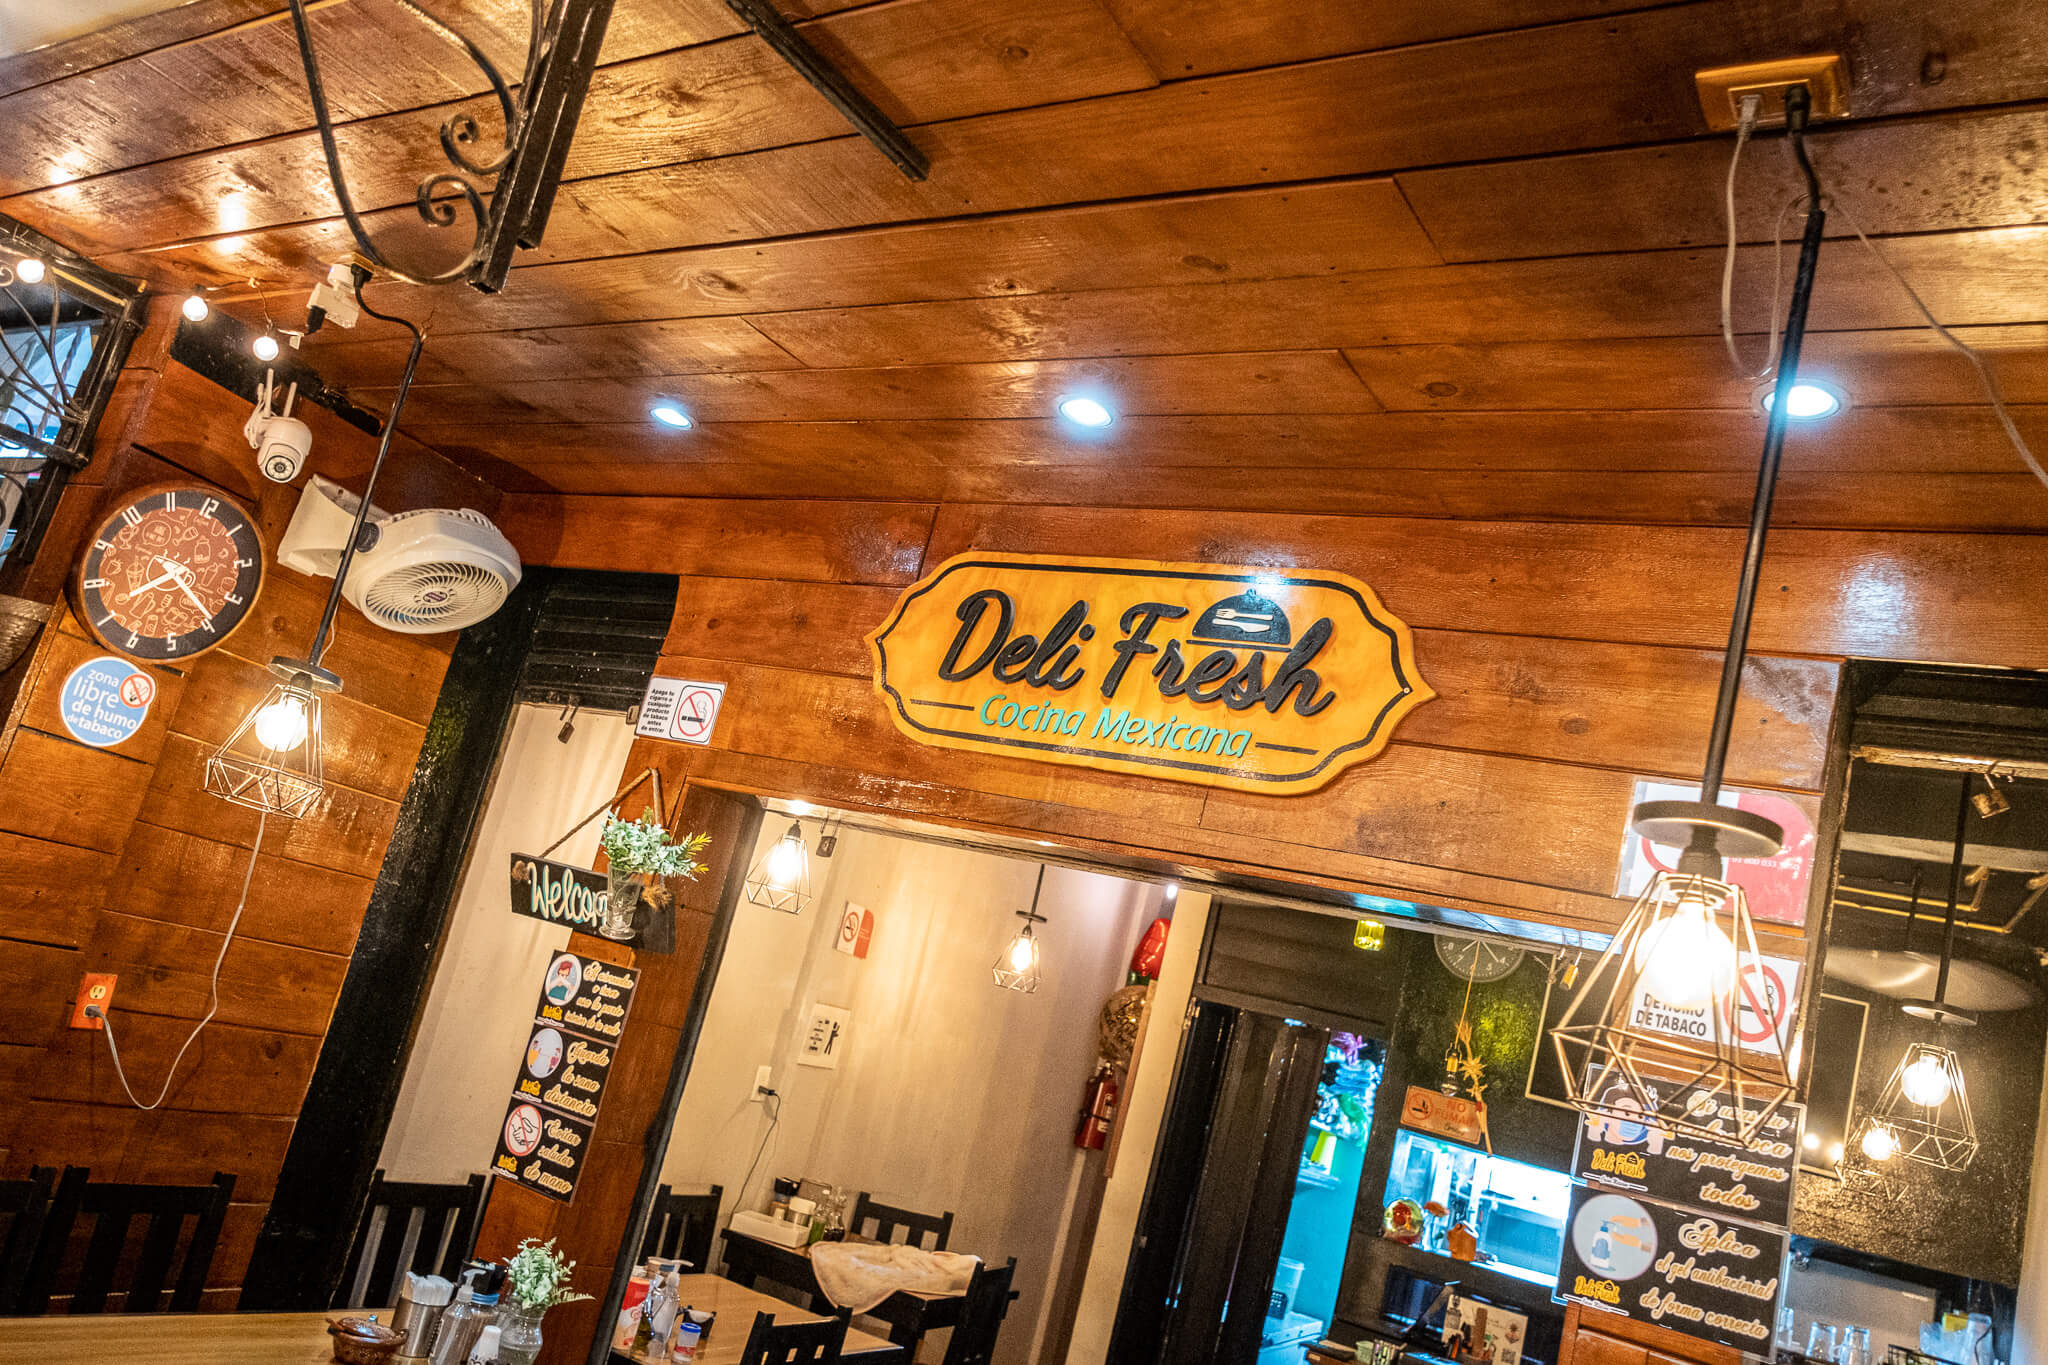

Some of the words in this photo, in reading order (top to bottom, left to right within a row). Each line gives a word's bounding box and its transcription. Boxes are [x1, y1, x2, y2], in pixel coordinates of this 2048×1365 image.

[166, 492, 176, 512] 11
[199, 497, 220, 520] 12
[121, 505, 143, 528] 10
[225, 523, 243, 537] 1
[95, 539, 115, 551] 9
[234, 558, 252, 569] 2
[83, 578, 105, 590] 8
[224, 592, 243, 605] 3
[97, 609, 116, 627] 7
[200, 618, 215, 633] 4
[125, 630, 139, 649] 6
[167, 632, 177, 652] 5
[938, 589, 1095, 690] Deli
[1100, 602, 1336, 716] Fresh
[88, 669, 120, 687] zona
[73, 676, 119, 708] libre
[67, 713, 79, 723] de
[78, 716, 122, 739] tabaco
[72, 699, 92, 715] de
[94, 704, 137, 730] humo
[980, 694, 1086, 735] Cocina
[1091, 708, 1252, 758] Mexicana
[527, 861, 610, 927] Welco
[1635, 1010, 1653, 1026] DE
[1656, 1014, 1706, 1036] TABACO
[567, 1041, 609, 1067] Guarda
[561, 1065, 575, 1084] la
[573, 1075, 600, 1092] sana
[544, 1083, 597, 1117] distancia
[1718, 1106, 1760, 1124] uas
[544, 1119, 581, 1147] Evitar
[538, 1144, 575, 1168] saludar
[1665, 1145, 1698, 1162] nos
[1690, 1152, 1790, 1182] protegemos
[523, 1160, 541, 1180] de
[538, 1172, 572, 1194] mano
[1700, 1182, 1760, 1210] todos
[1679, 1218, 1760, 1259] Aplica
[1655, 1251, 1675, 1273] el
[1666, 1257, 1695, 1283] gel
[1690, 1266, 1777, 1300] antibacterial
[1640, 1286, 1660, 1308] de
[1651, 1292, 1705, 1321] forma
[1705, 1311, 1769, 1340] correcta
